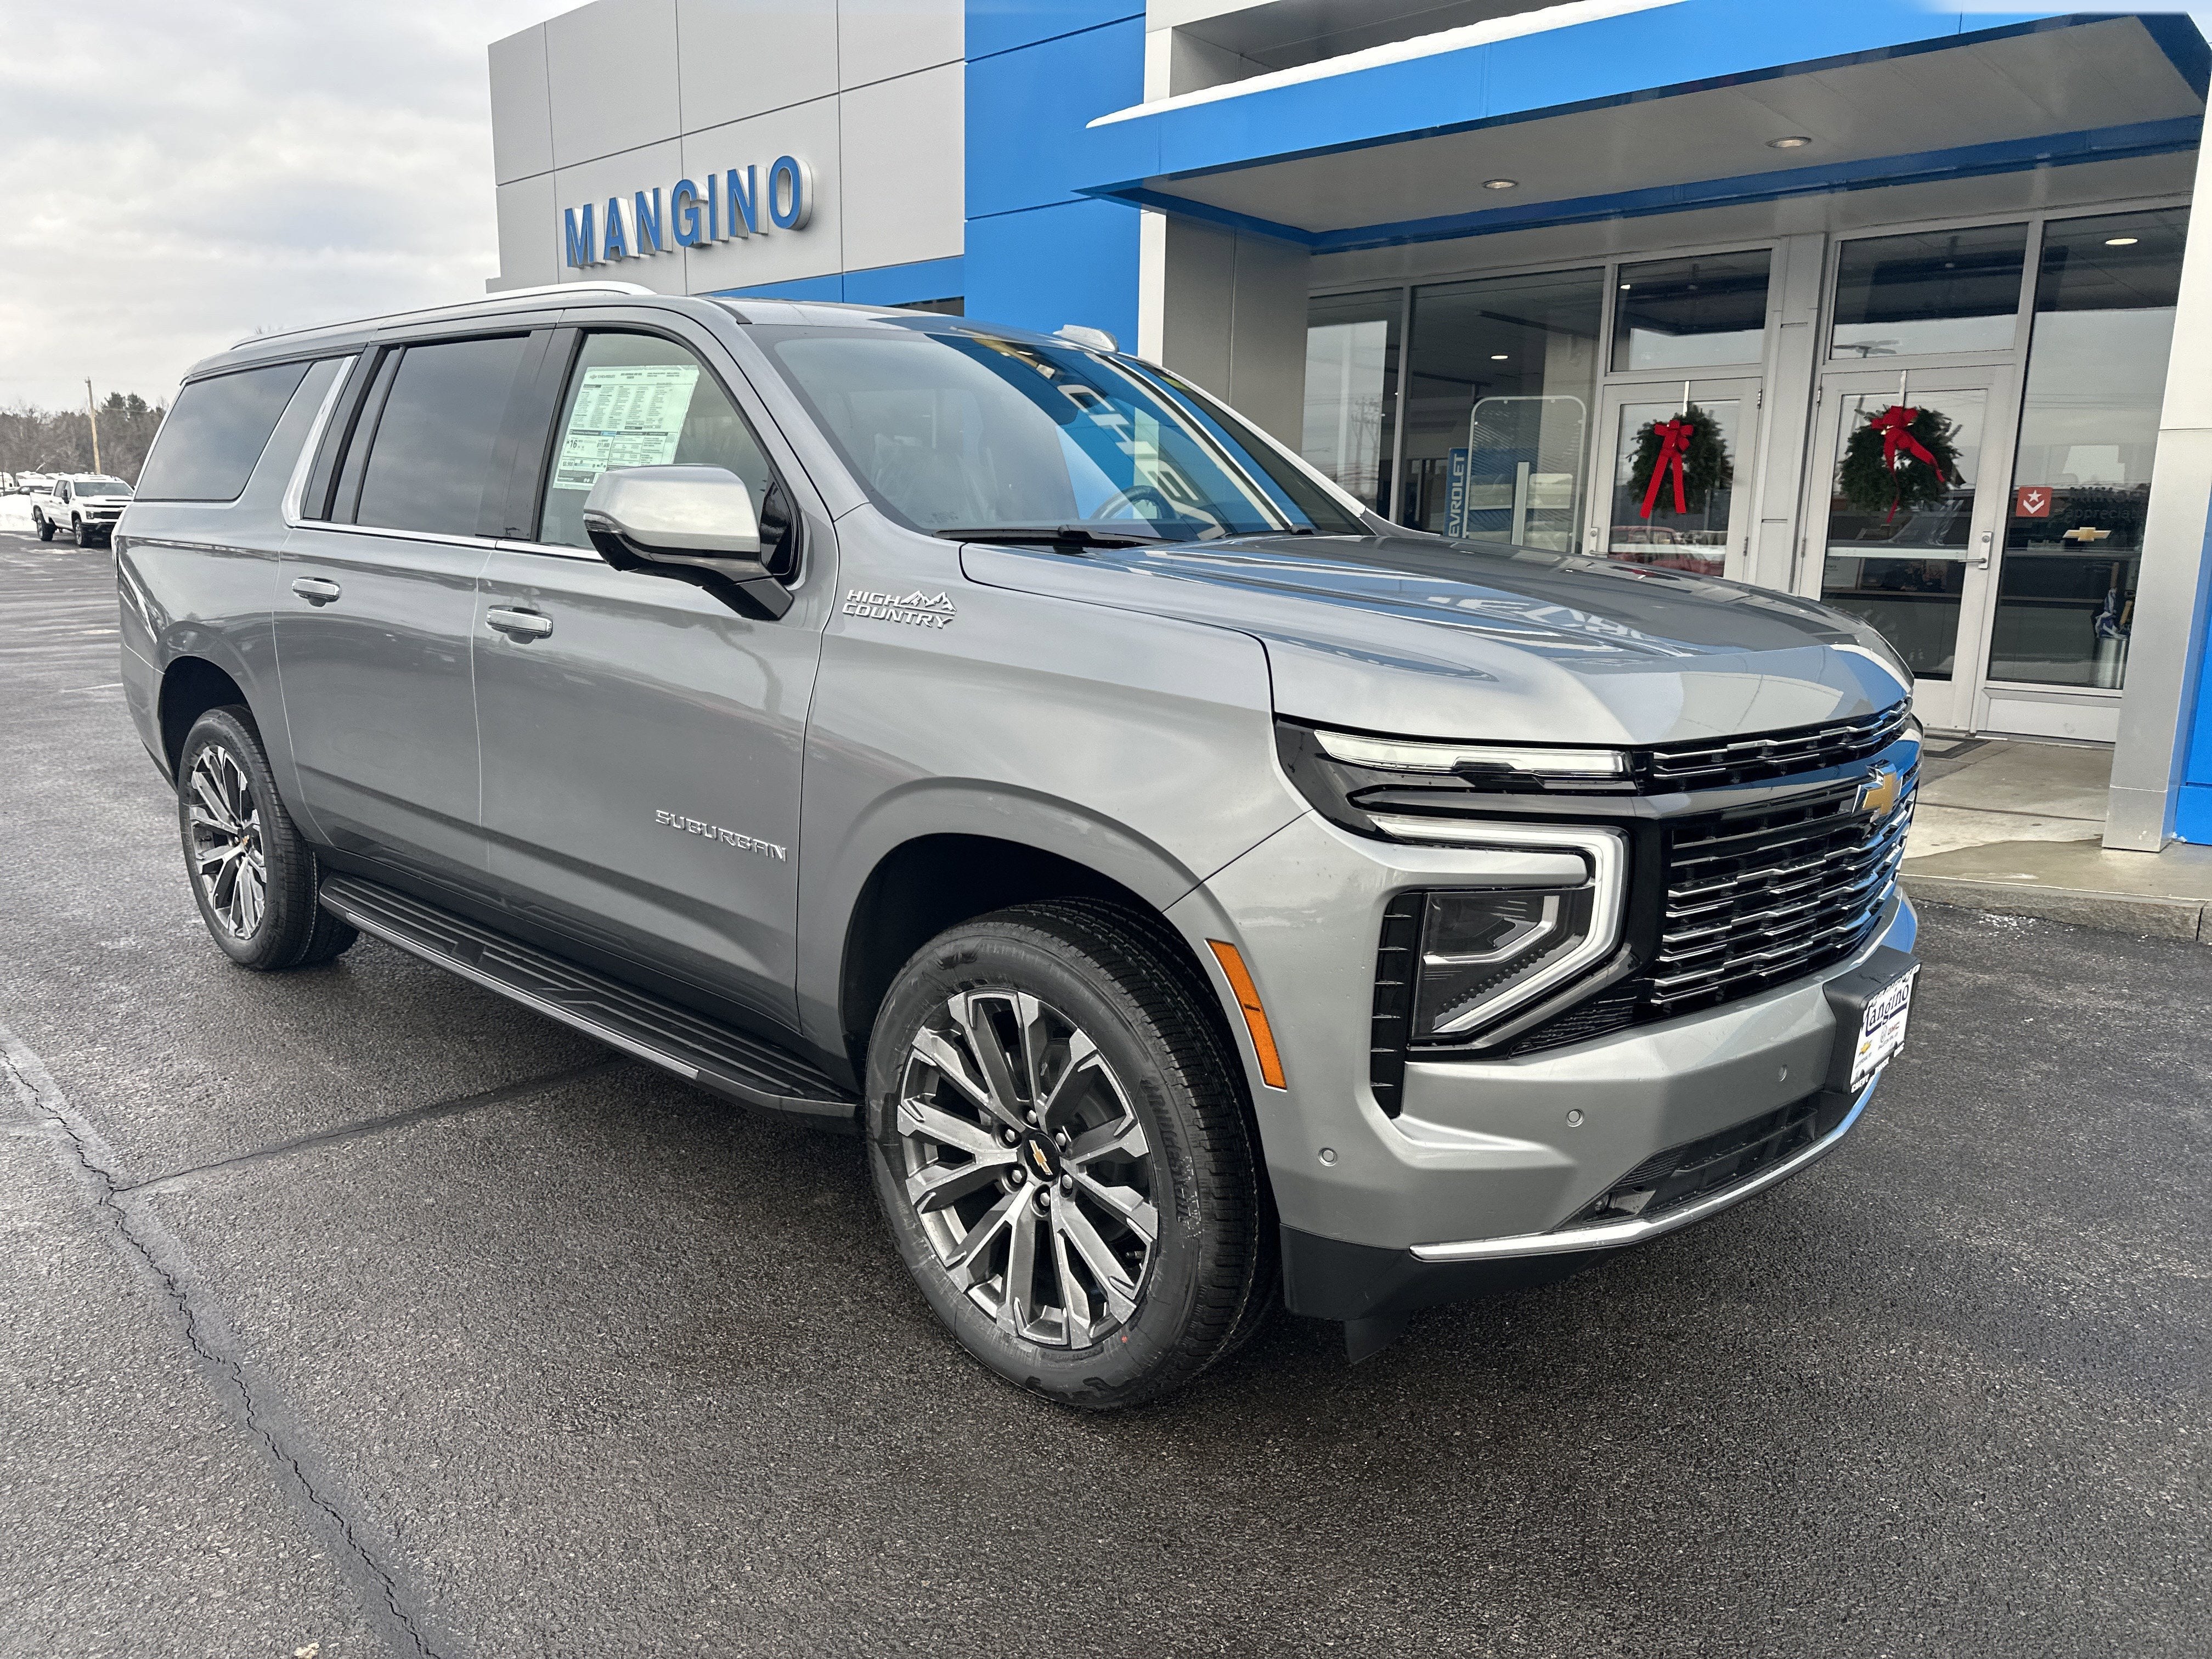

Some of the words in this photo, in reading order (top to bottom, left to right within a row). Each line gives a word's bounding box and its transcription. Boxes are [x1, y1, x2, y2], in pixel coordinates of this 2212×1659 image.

[565, 155, 812, 268] MANGINO
[842, 602, 953, 630] COUNTRY
[847, 589, 901, 607] HIGH
[655, 809, 787, 862] SUBURBAN
